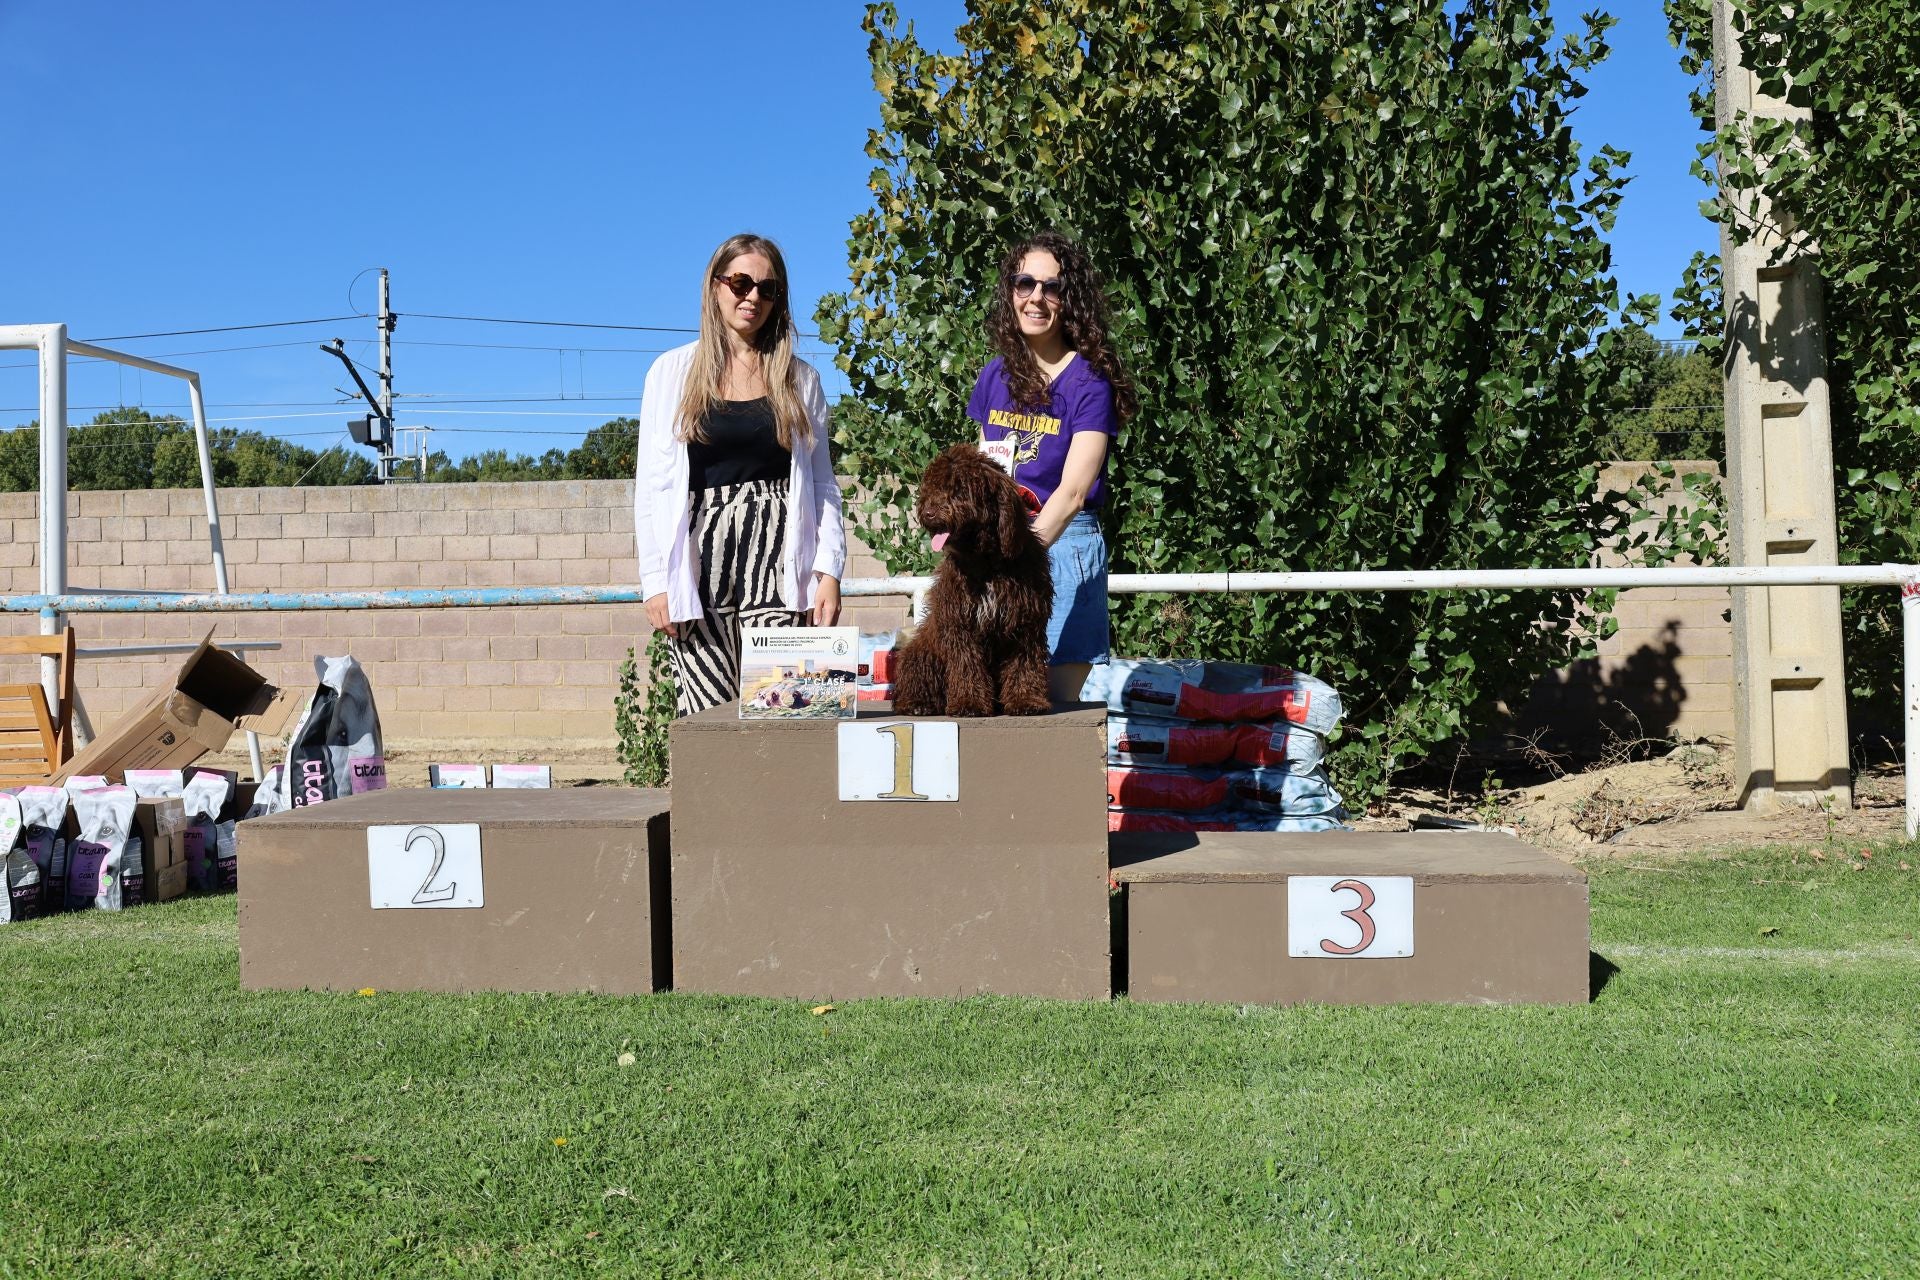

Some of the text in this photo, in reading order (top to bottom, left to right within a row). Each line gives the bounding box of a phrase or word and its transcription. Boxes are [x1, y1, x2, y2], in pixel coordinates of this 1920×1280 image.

[982, 446, 1012, 458] RION
[752, 637, 768, 647] VII
[814, 677, 845, 686] CLASE
[303, 760, 326, 806] tita
[876, 723, 929, 800] 1
[405, 825, 456, 904] 2
[1320, 879, 1376, 955] 3
